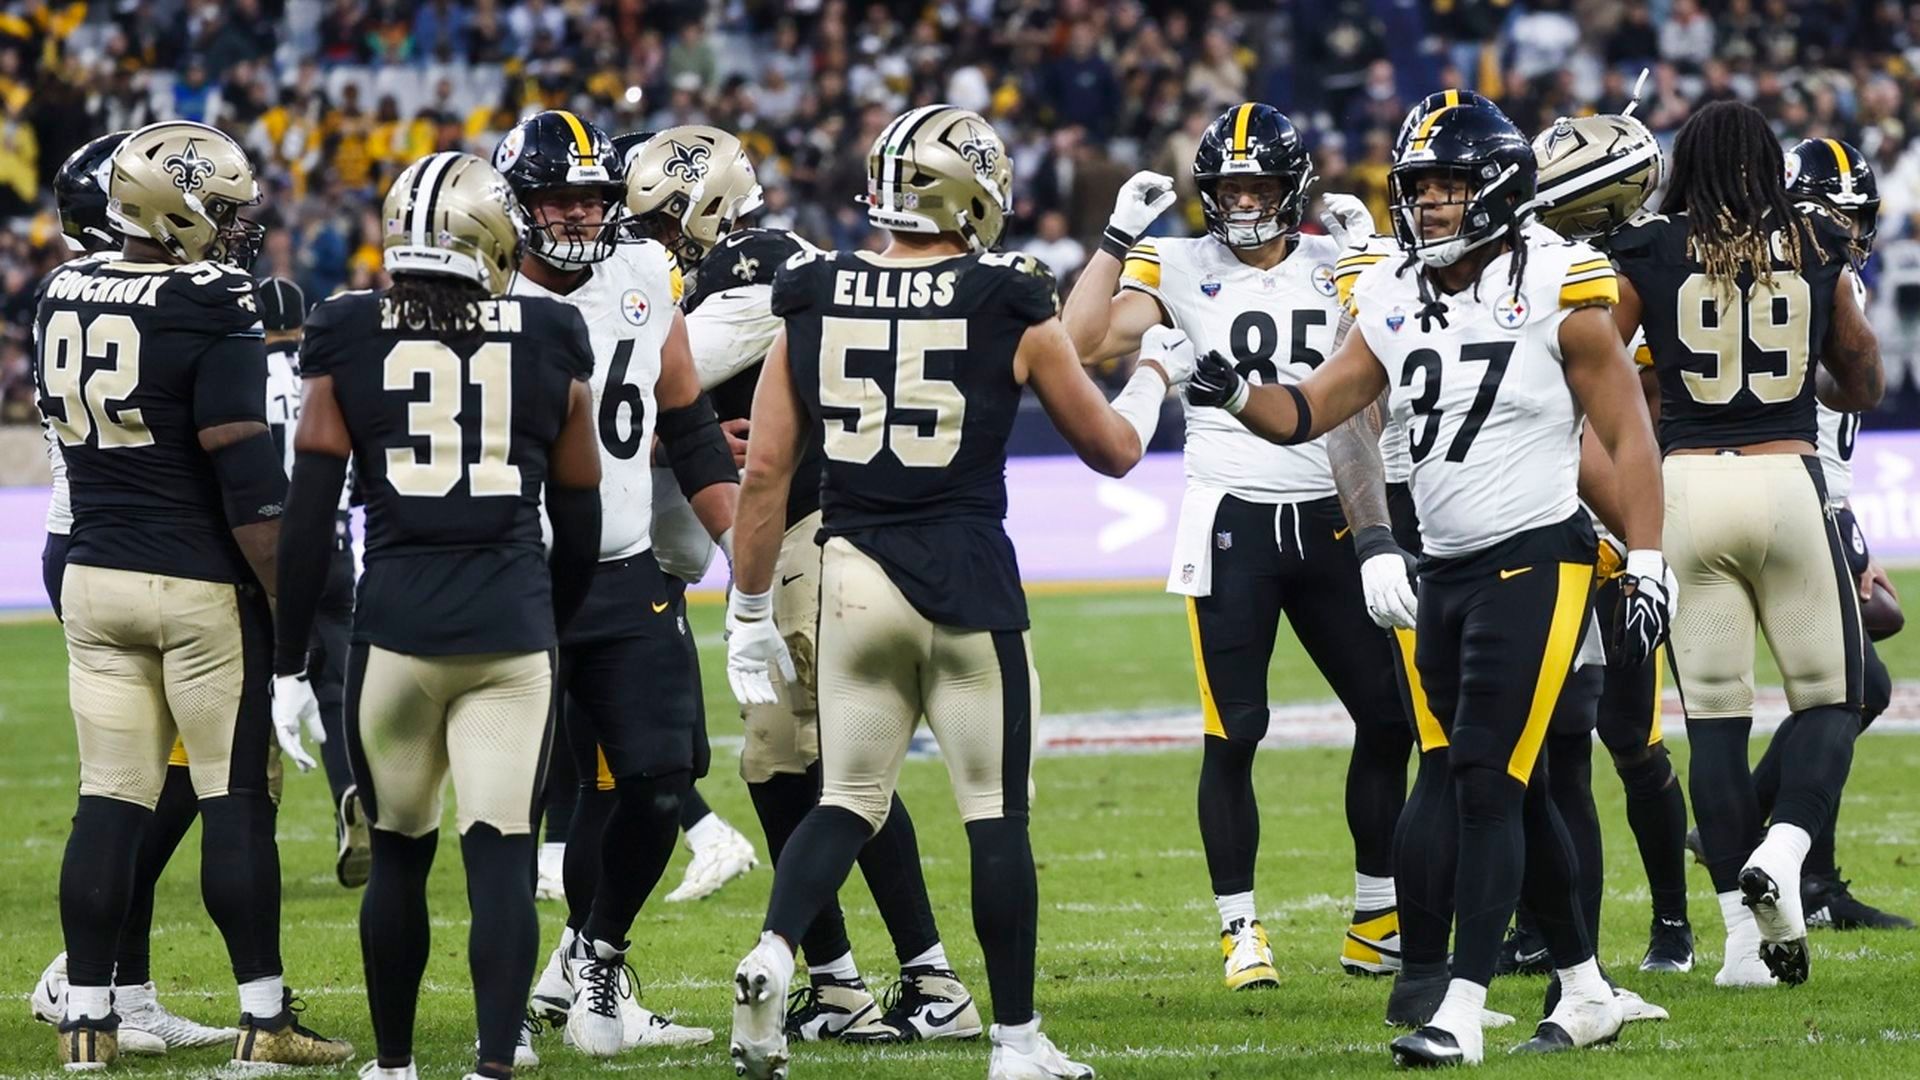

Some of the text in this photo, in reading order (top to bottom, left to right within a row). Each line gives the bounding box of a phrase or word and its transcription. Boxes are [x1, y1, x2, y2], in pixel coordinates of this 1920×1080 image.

[47, 269, 169, 307] GODCHAUX
[833, 270, 956, 308] ELLISS
[1677, 270, 1811, 404] 99
[44, 311, 155, 449] 92
[383, 340, 522, 497] 31
[819, 316, 967, 467] 55
[1399, 341, 1517, 464] 37
